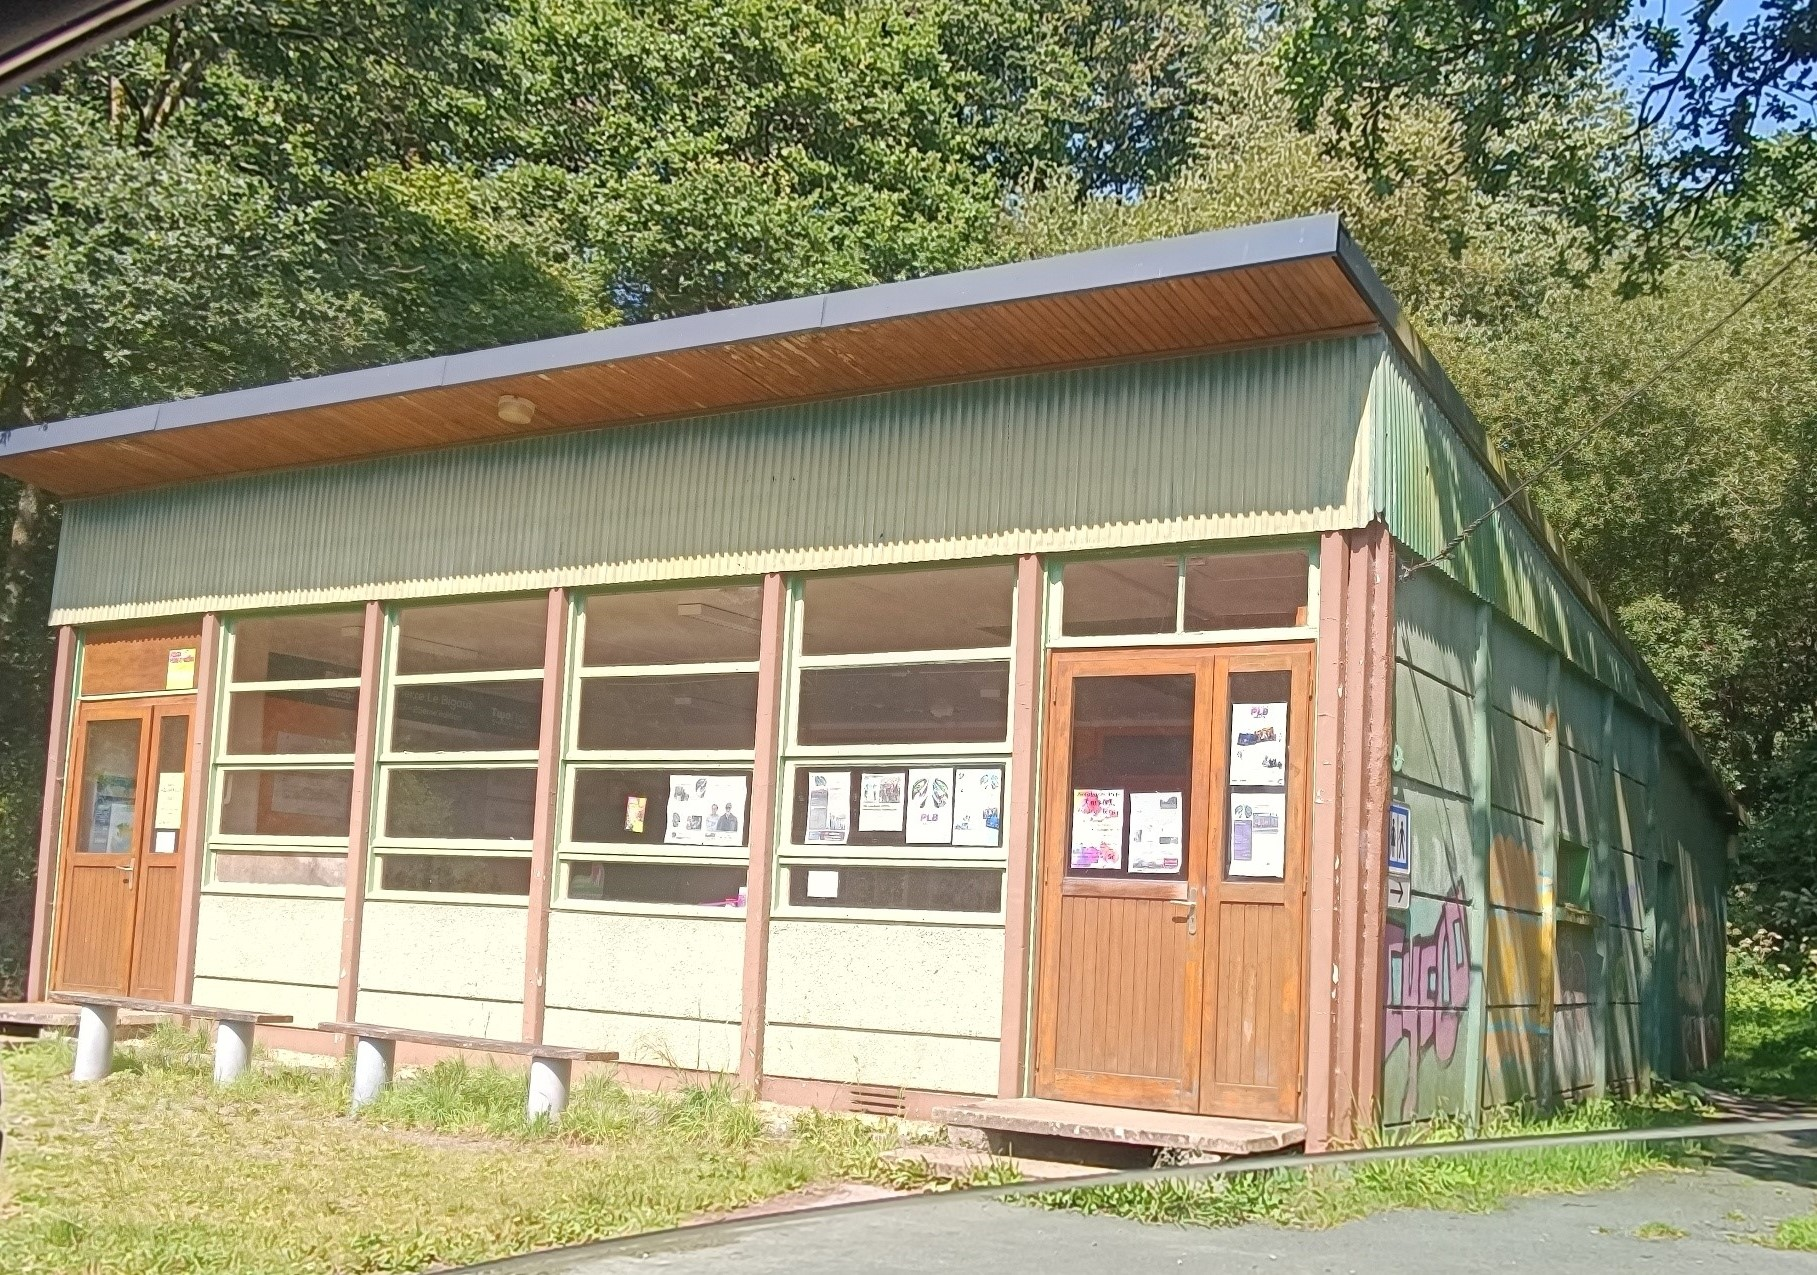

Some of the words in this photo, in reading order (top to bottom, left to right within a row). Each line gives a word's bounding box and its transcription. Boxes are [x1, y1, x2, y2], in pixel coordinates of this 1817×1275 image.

[399, 690, 425, 702] ierre
[427, 692, 439, 703] Le
[920, 813, 939, 822] PLB
